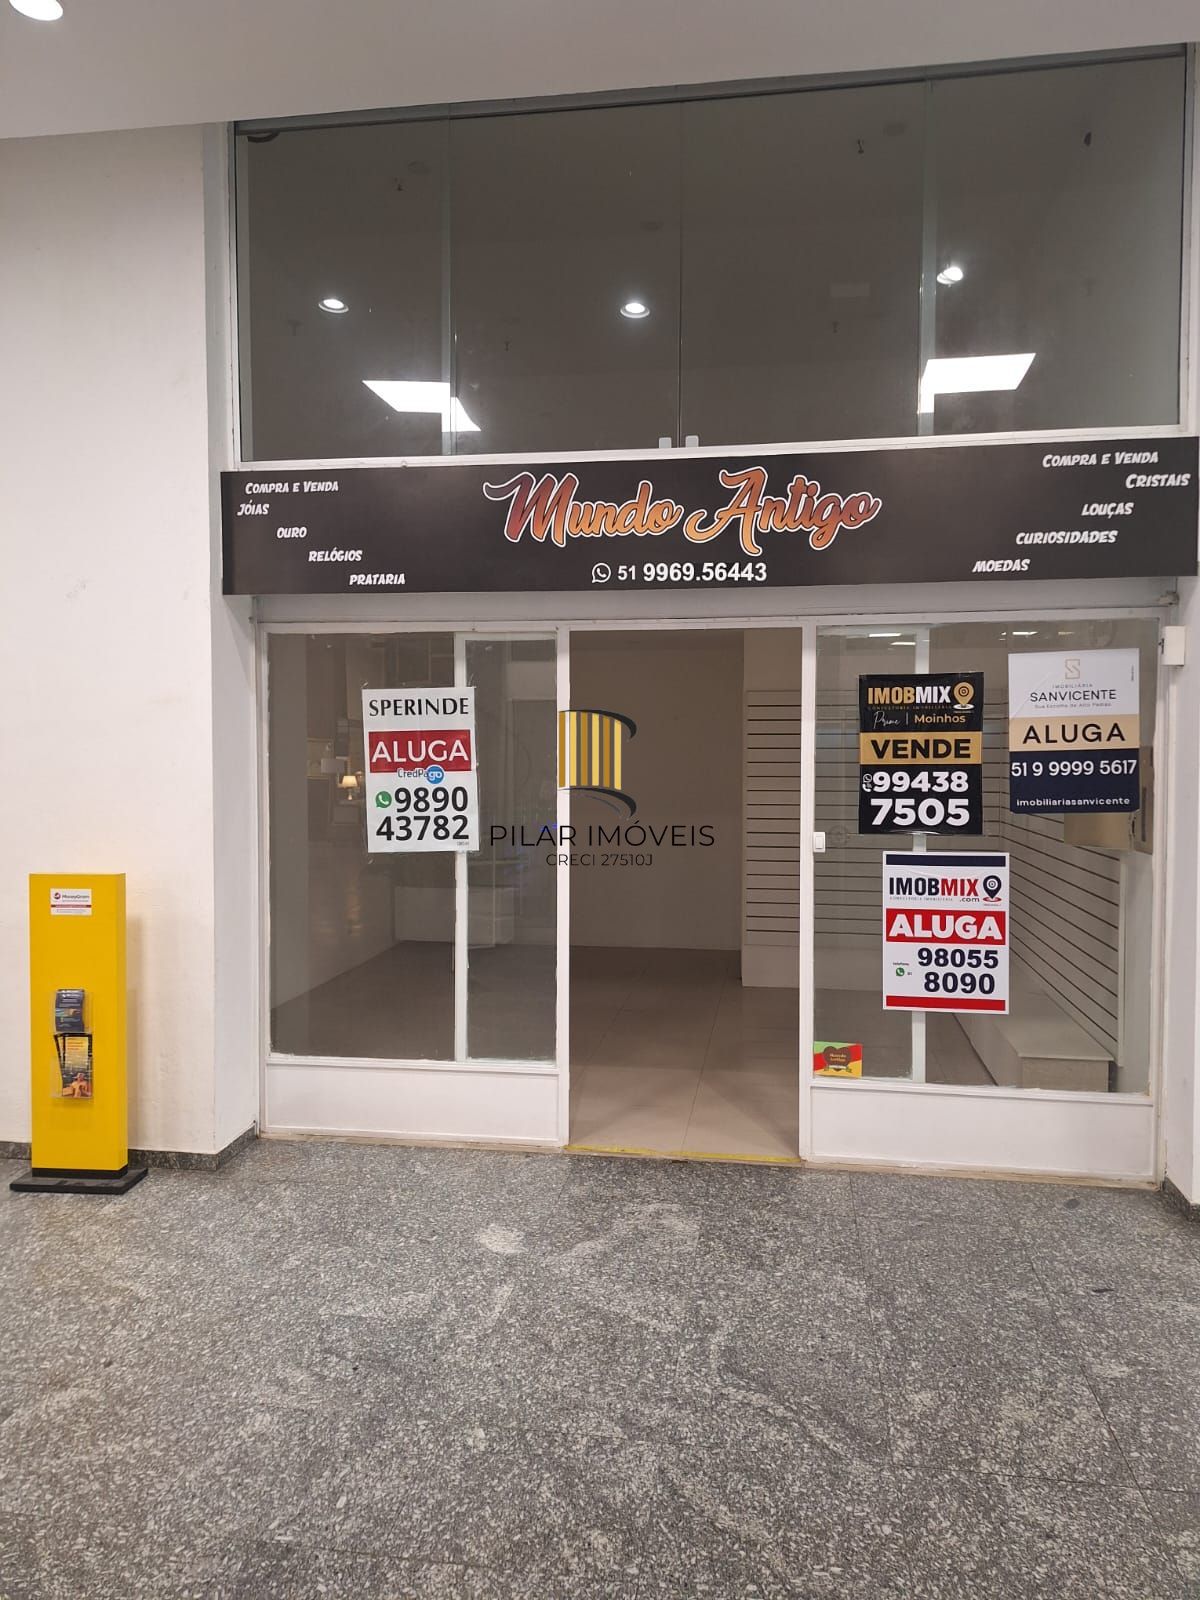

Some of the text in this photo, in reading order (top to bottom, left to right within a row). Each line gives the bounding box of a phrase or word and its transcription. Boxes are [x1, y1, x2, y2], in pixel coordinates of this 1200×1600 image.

[237, 499, 269, 516] JÓIAS
[483, 466, 882, 557] Mundo Antigo
[1081, 502, 1135, 518] LOUÇAS
[276, 526, 308, 539] OURO
[1016, 530, 1119, 545] CURIOSIDADES
[308, 547, 363, 562] RELÓGIOS
[617, 562, 767, 582] 51 9969.56443
[972, 558, 1031, 573] MOEDAS
[349, 573, 406, 586] PRATARIA
[868, 686, 951, 704] IMOBMIX
[1030, 689, 1117, 703] SANVICENTE
[369, 698, 469, 717] SPERINDE
[914, 713, 967, 724] Moinhos
[1022, 722, 1126, 745] ALUGA
[371, 739, 469, 763] ALUGA
[871, 738, 971, 759] VENDE
[1011, 760, 1137, 777] 51 9 9999 5617
[872, 770, 969, 793] 99438
[394, 786, 469, 813] 9890
[1016, 797, 1131, 807] imobiliariasanvicente
[870, 797, 970, 826] 7505
[375, 814, 469, 841] 43782
[889, 877, 979, 896] IMOBMIX
[889, 913, 1003, 940] ALUGA
[917, 947, 999, 969] 98055
[924, 971, 995, 994] 8090
